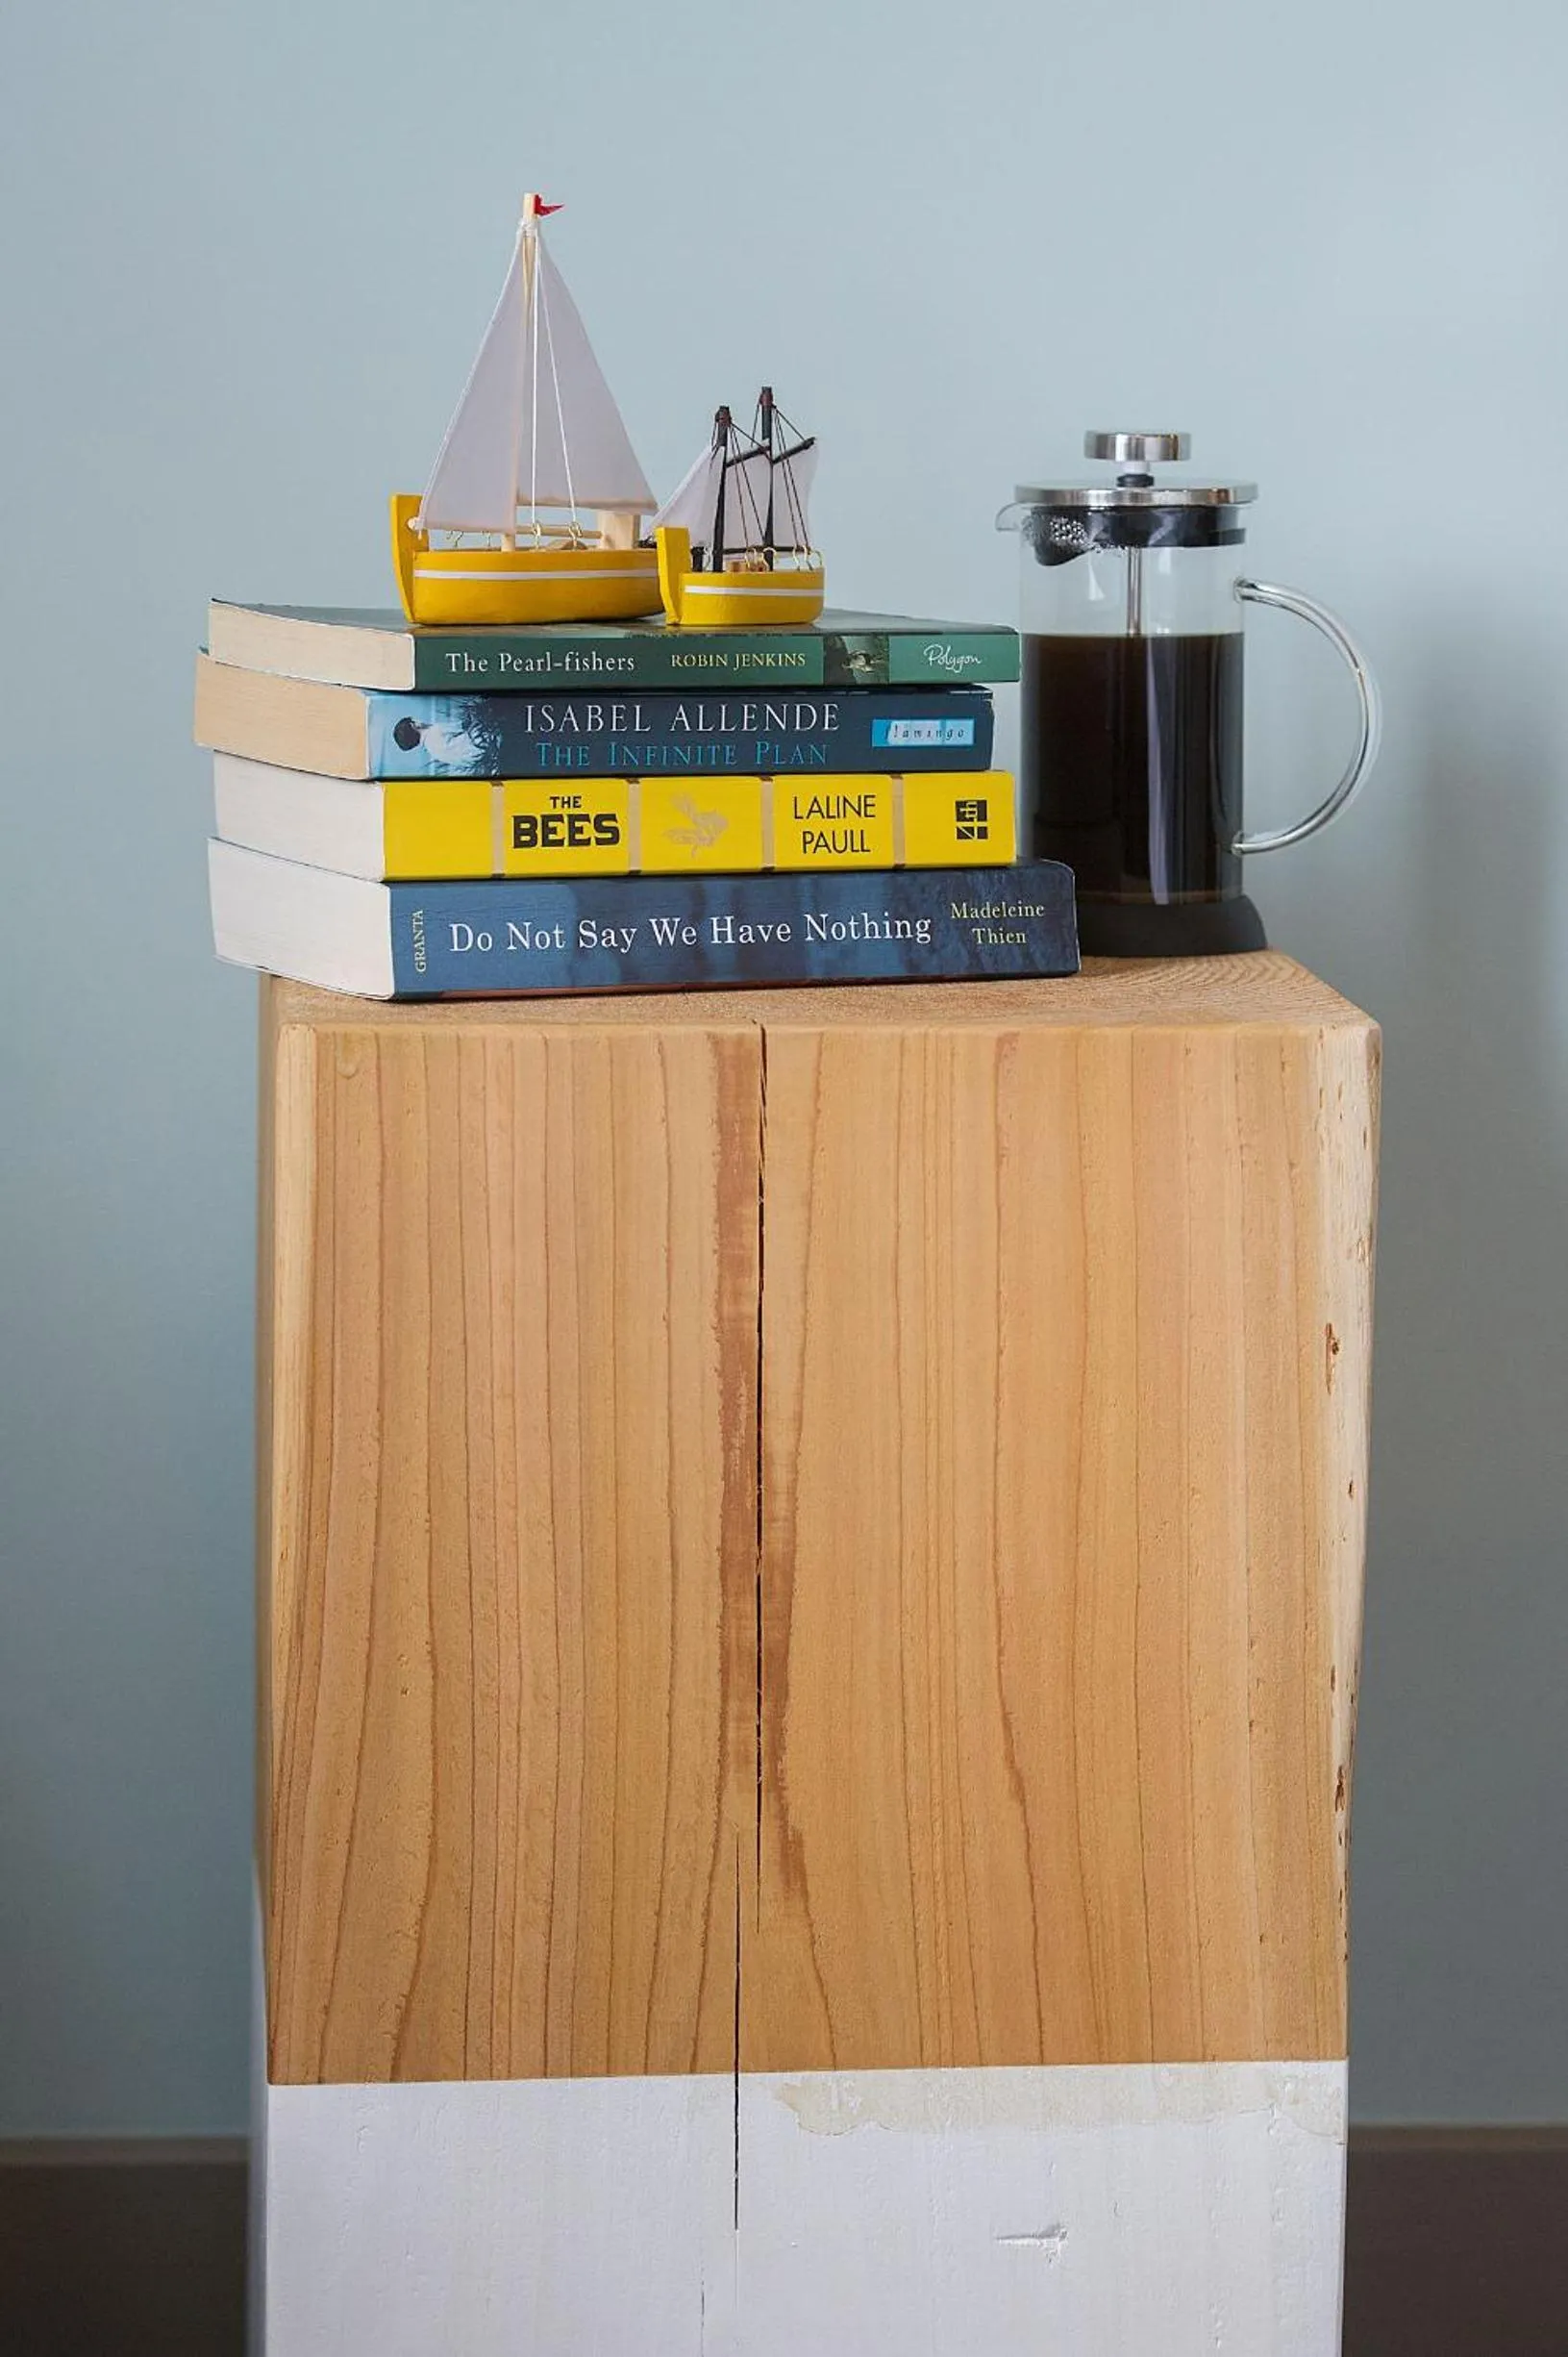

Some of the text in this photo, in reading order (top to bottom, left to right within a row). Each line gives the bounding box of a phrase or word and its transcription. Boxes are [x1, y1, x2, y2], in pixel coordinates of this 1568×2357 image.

[445, 651, 635, 672] The Pearl-fishers
[671, 652, 806, 671] ROBIN JENKINS
[923, 643, 983, 673] Polygon
[524, 702, 840, 733] ISABEL ALLENDE
[549, 795, 583, 809] THE
[792, 793, 878, 820] LALINE
[512, 814, 620, 849] BEES
[801, 829, 871, 854] PAULL
[950, 900, 1045, 919] Madeleine
[411, 909, 426, 973] GRANTA
[449, 911, 933, 954] Do Not Say We Have Nothing
[972, 927, 1027, 945] Thien
